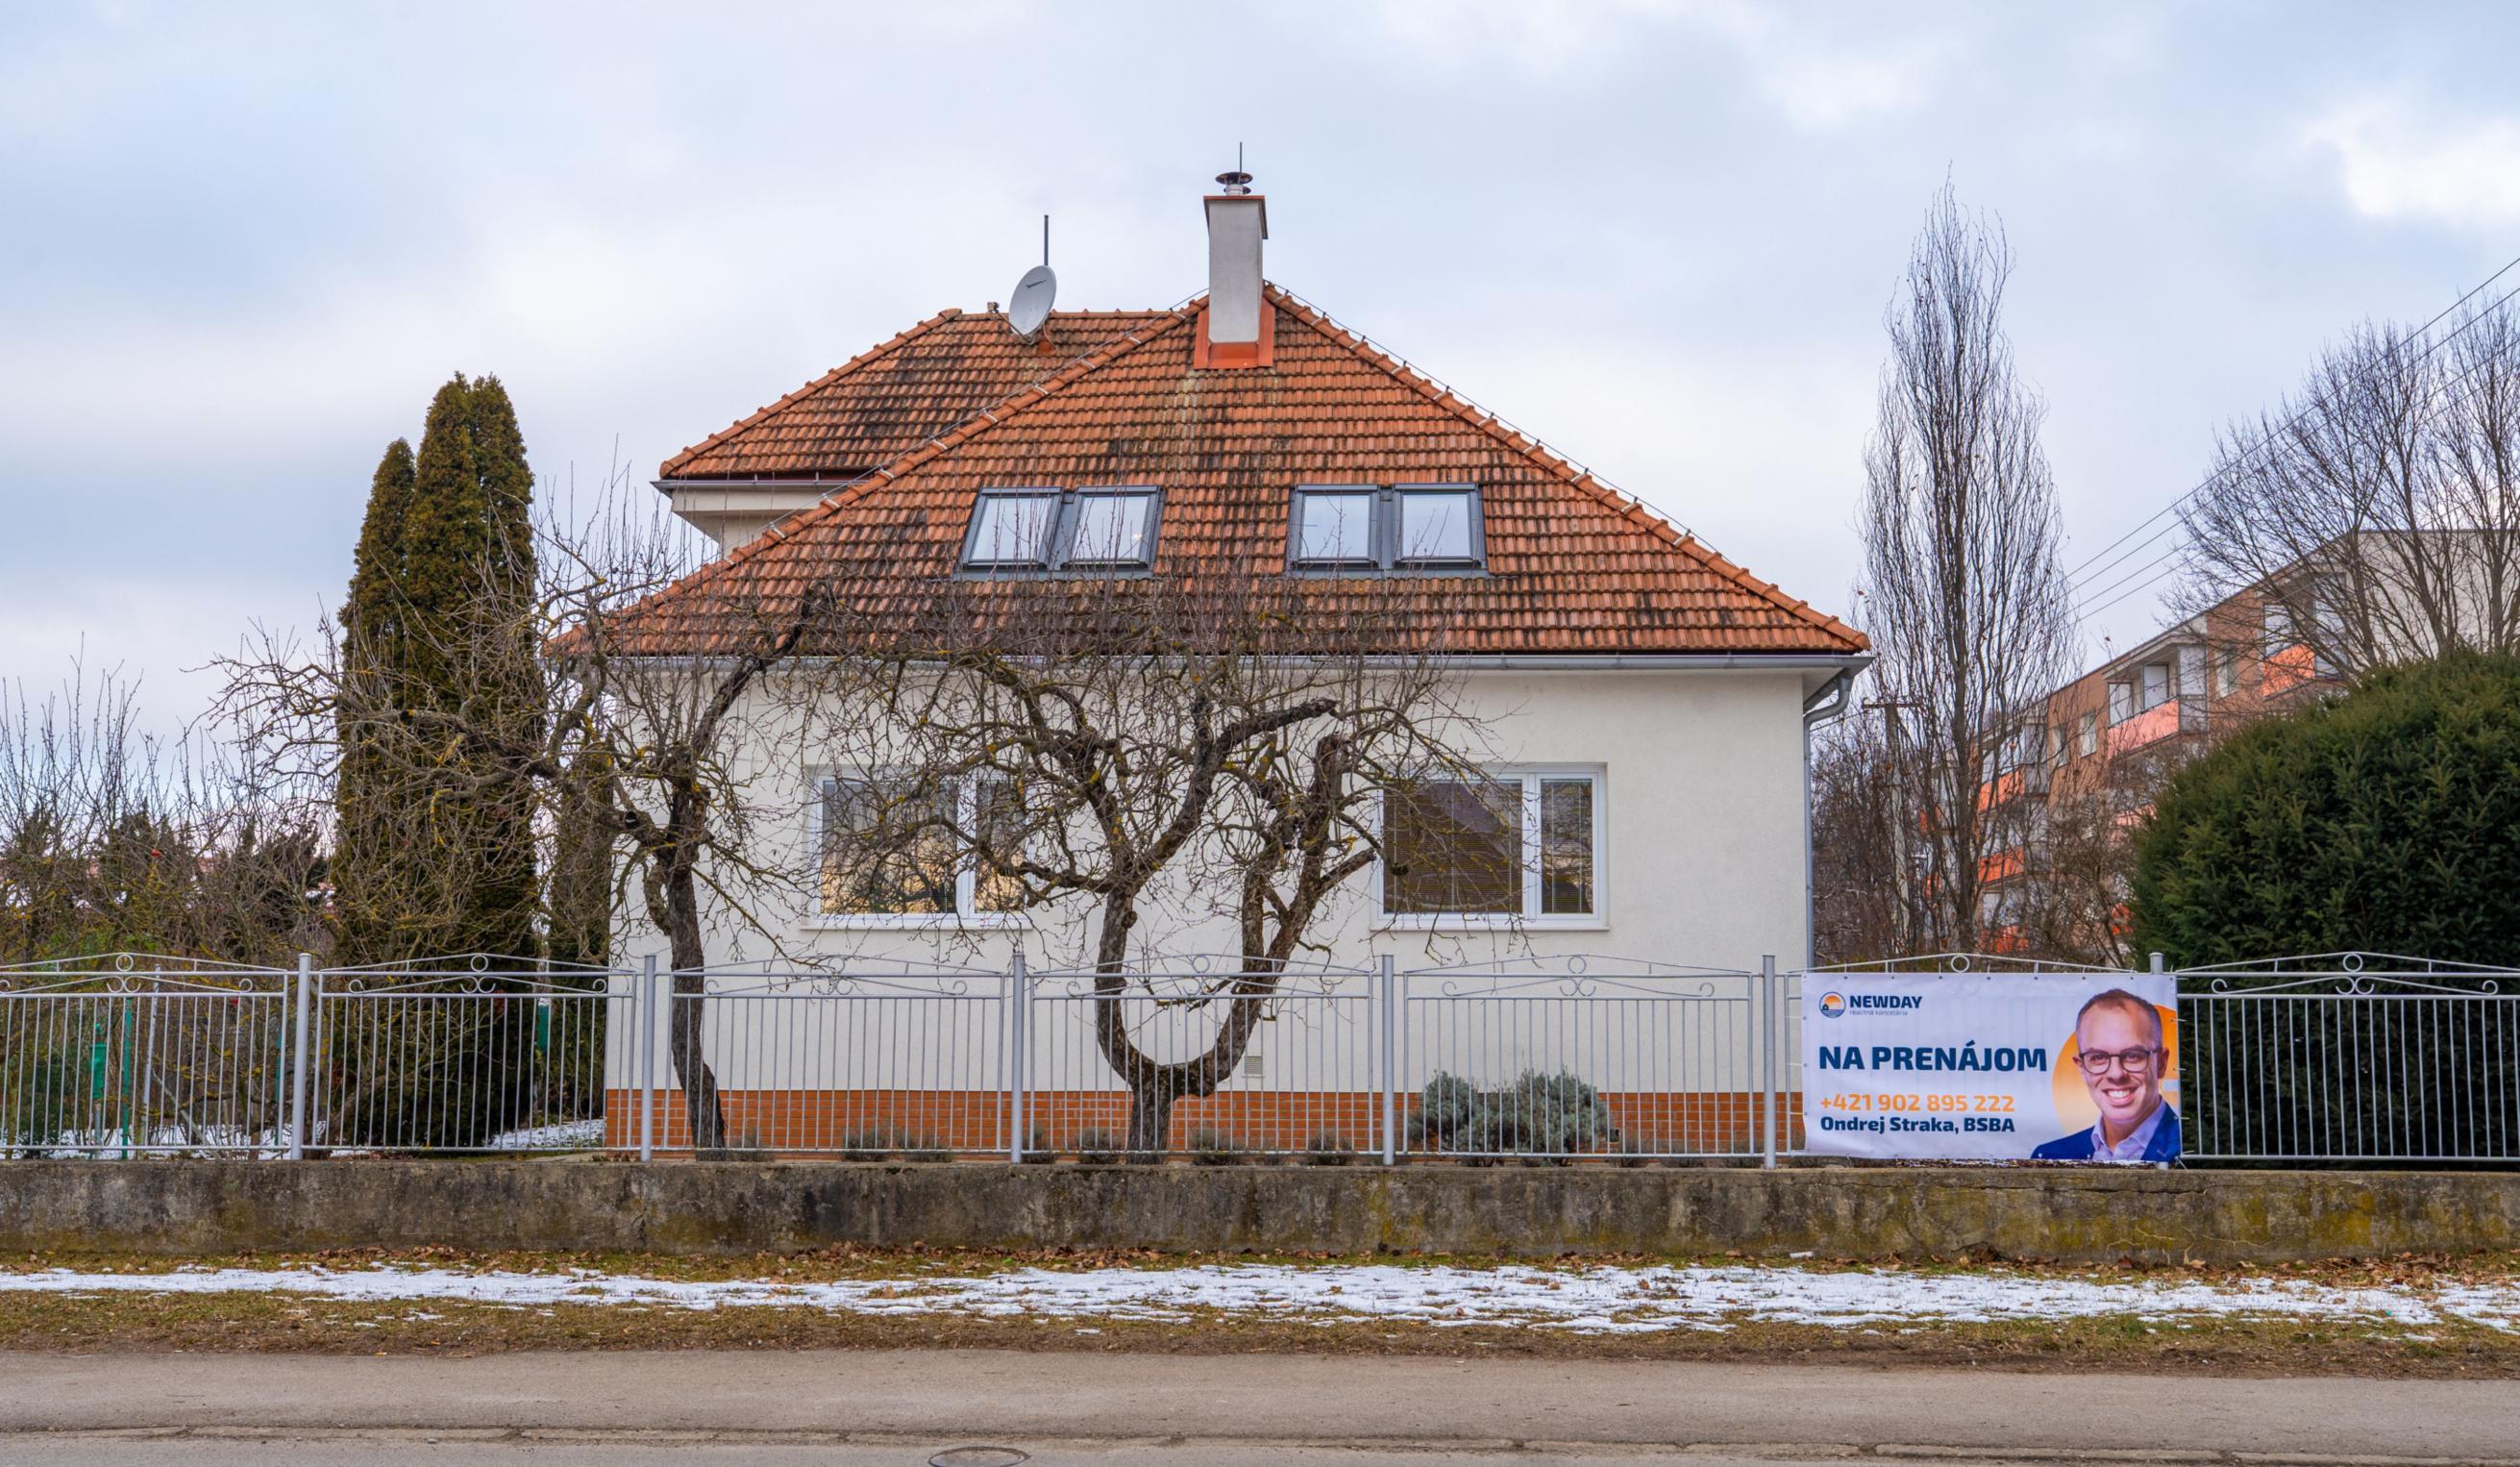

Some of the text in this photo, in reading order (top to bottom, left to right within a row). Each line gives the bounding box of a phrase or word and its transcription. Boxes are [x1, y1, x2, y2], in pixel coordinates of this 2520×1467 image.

[1849, 995, 1922, 1008] NEWDAY
[1819, 1040, 2047, 1072] NA PRENÁJOM
[1820, 1094, 2014, 1112] +421 902 895 222
[1820, 1116, 2014, 1134] Ondrej Straka, BSBA
